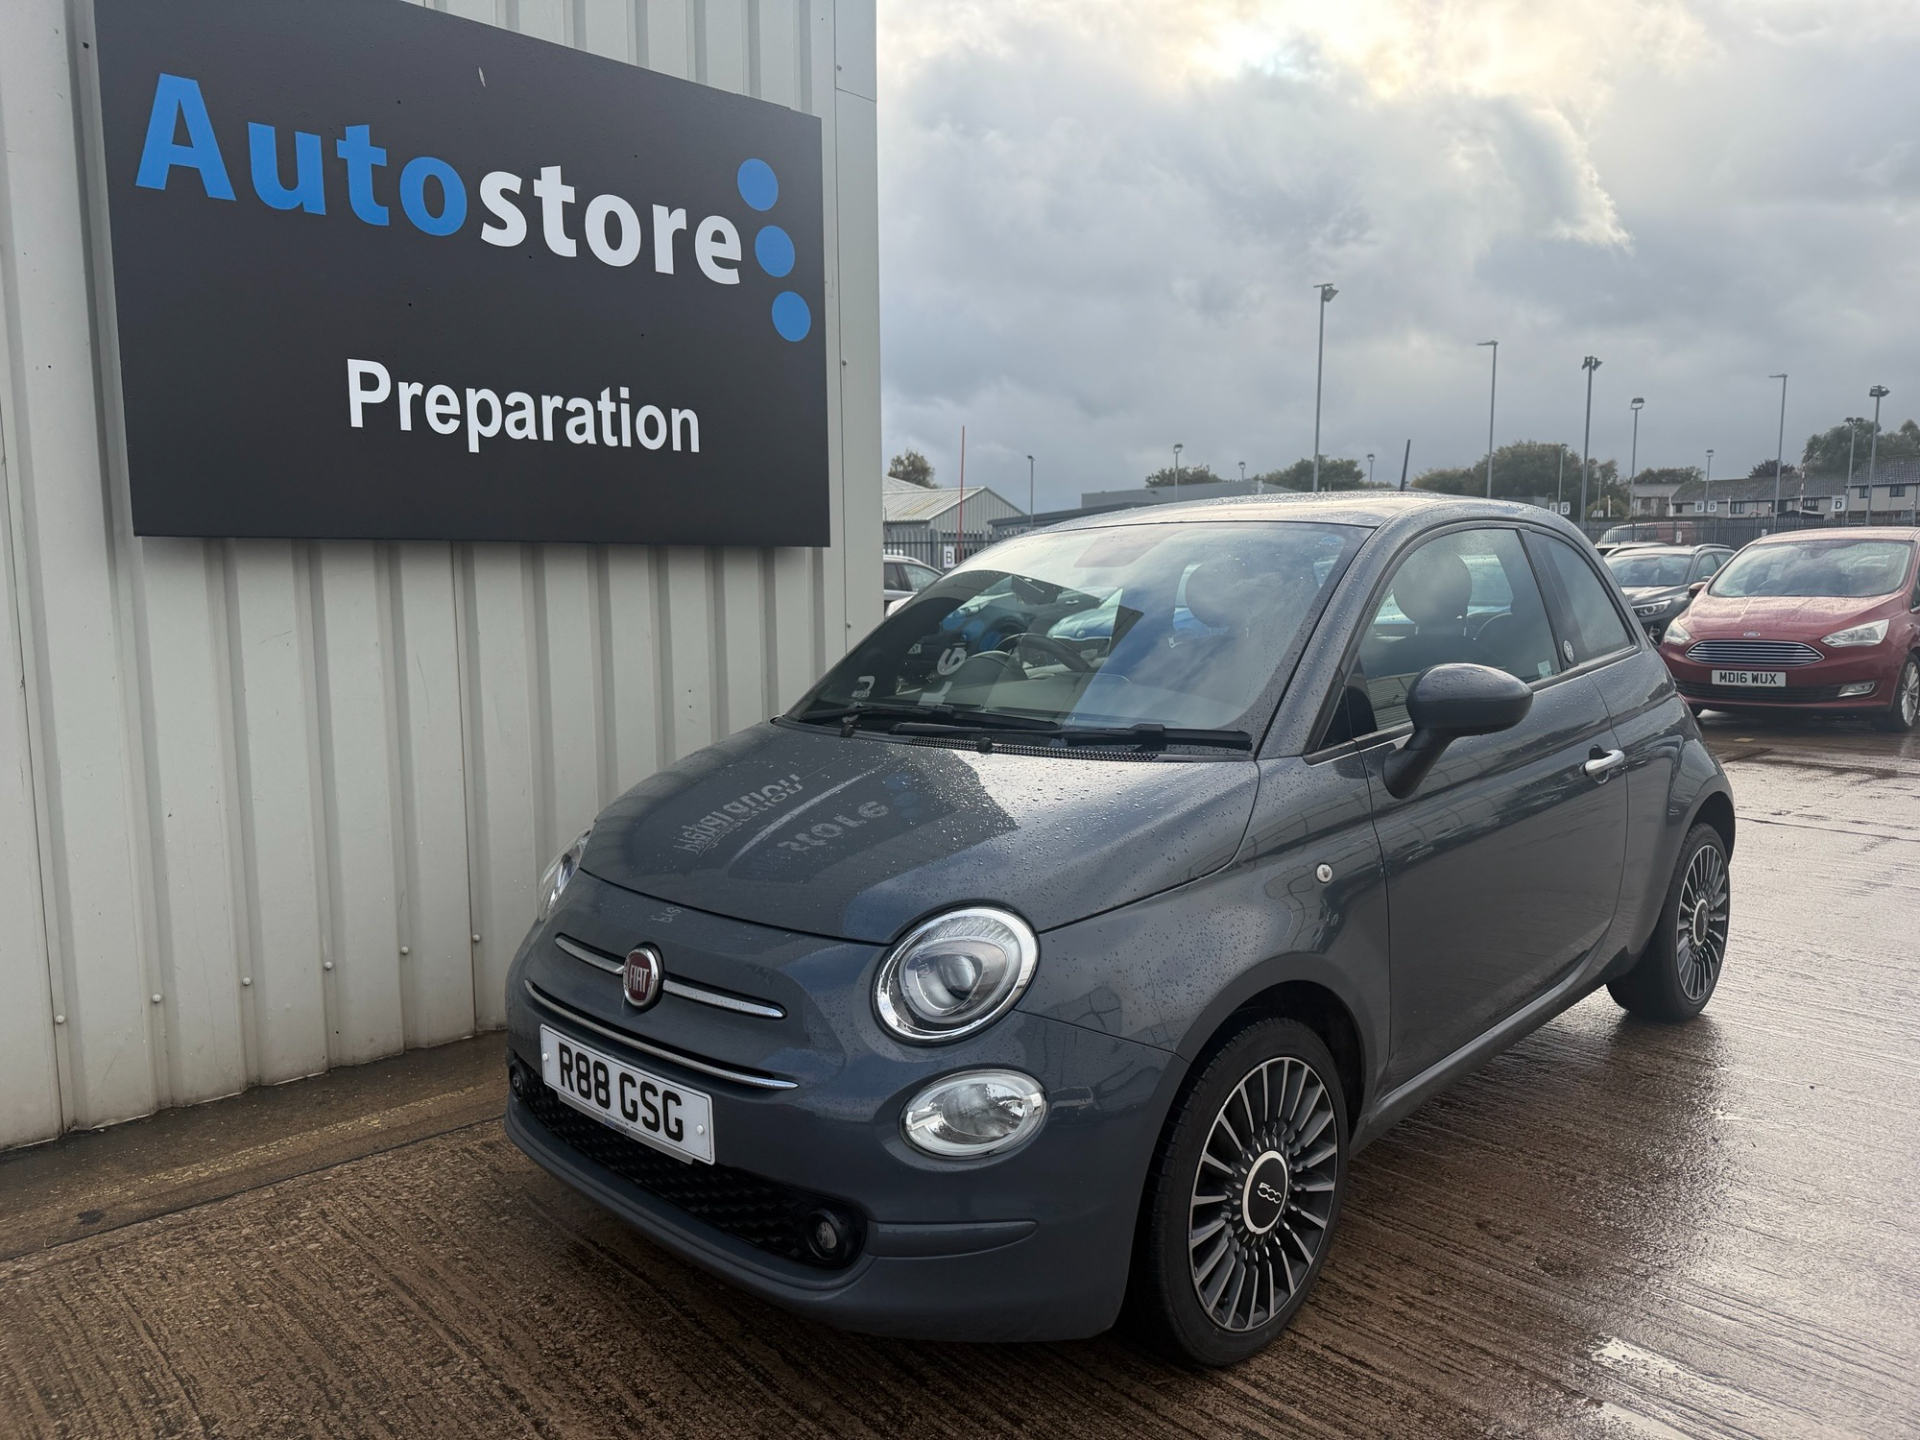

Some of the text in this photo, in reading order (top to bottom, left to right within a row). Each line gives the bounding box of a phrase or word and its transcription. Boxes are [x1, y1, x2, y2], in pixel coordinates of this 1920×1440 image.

[135, 72, 742, 285] Autostore
[346, 358, 700, 453] Preparation
[945, 551, 953, 564] B
[1719, 671, 1777, 685] MD16 WUX
[629, 964, 650, 993] FIAT
[558, 1042, 684, 1142] R88 GSG
[1257, 1182, 1282, 1204] 500
